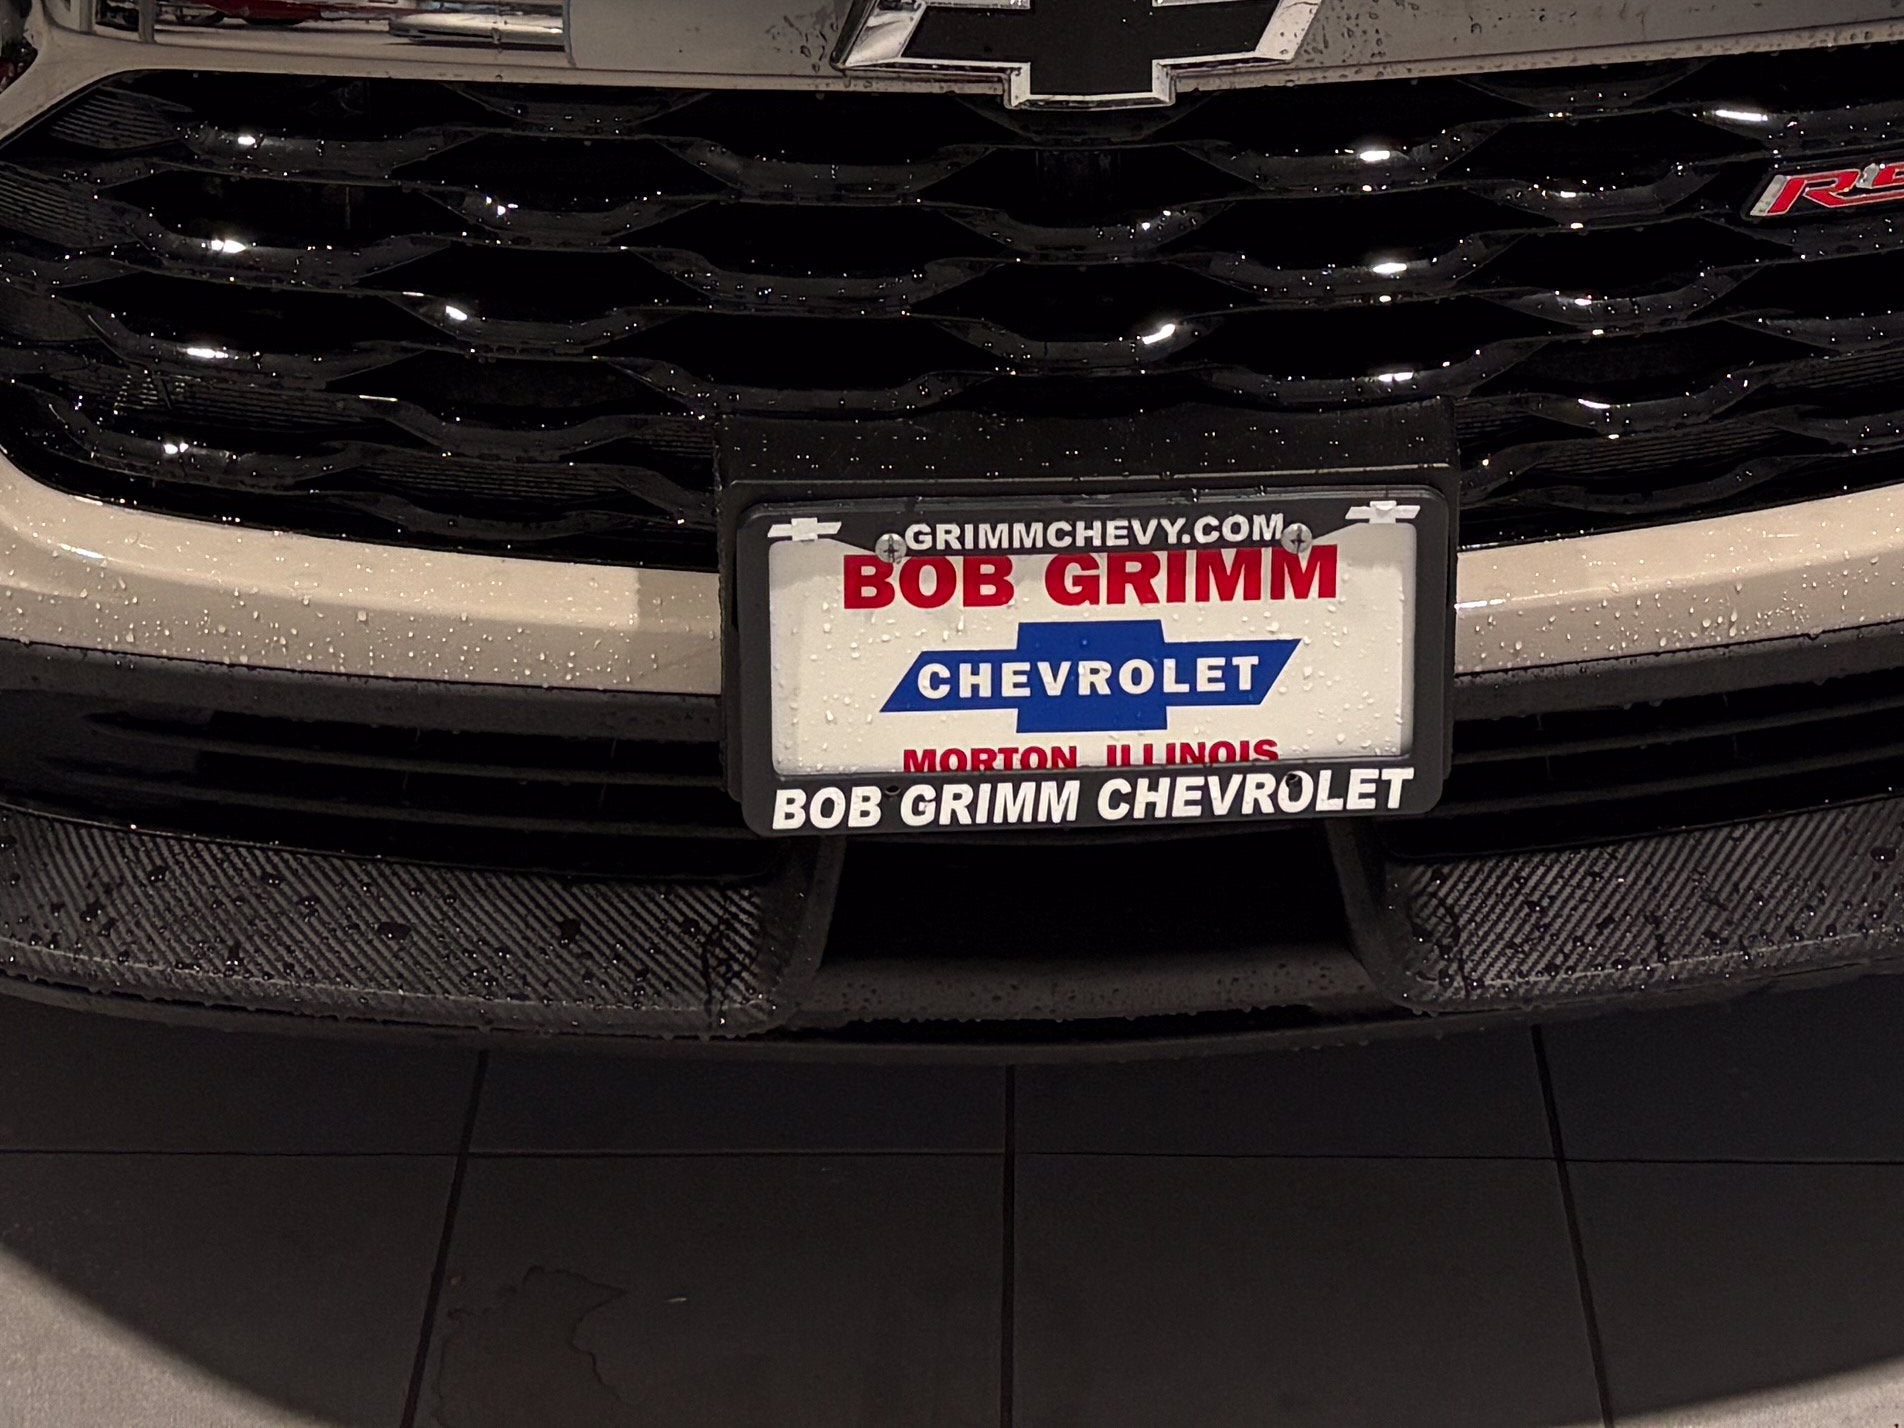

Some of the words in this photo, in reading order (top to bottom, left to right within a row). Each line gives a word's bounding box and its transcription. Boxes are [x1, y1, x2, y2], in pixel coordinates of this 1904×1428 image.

[904, 512, 1285, 551] GRIMMCHEVY.COM
[843, 553, 1015, 610] BOB
[1043, 543, 1338, 607] GRIMM
[917, 655, 1260, 700] CHEVROLET
[903, 745, 1078, 773] MORTON
[772, 785, 883, 831] BOB
[899, 779, 1081, 826] GRIMM
[1097, 766, 1415, 821] CHEVROLET
